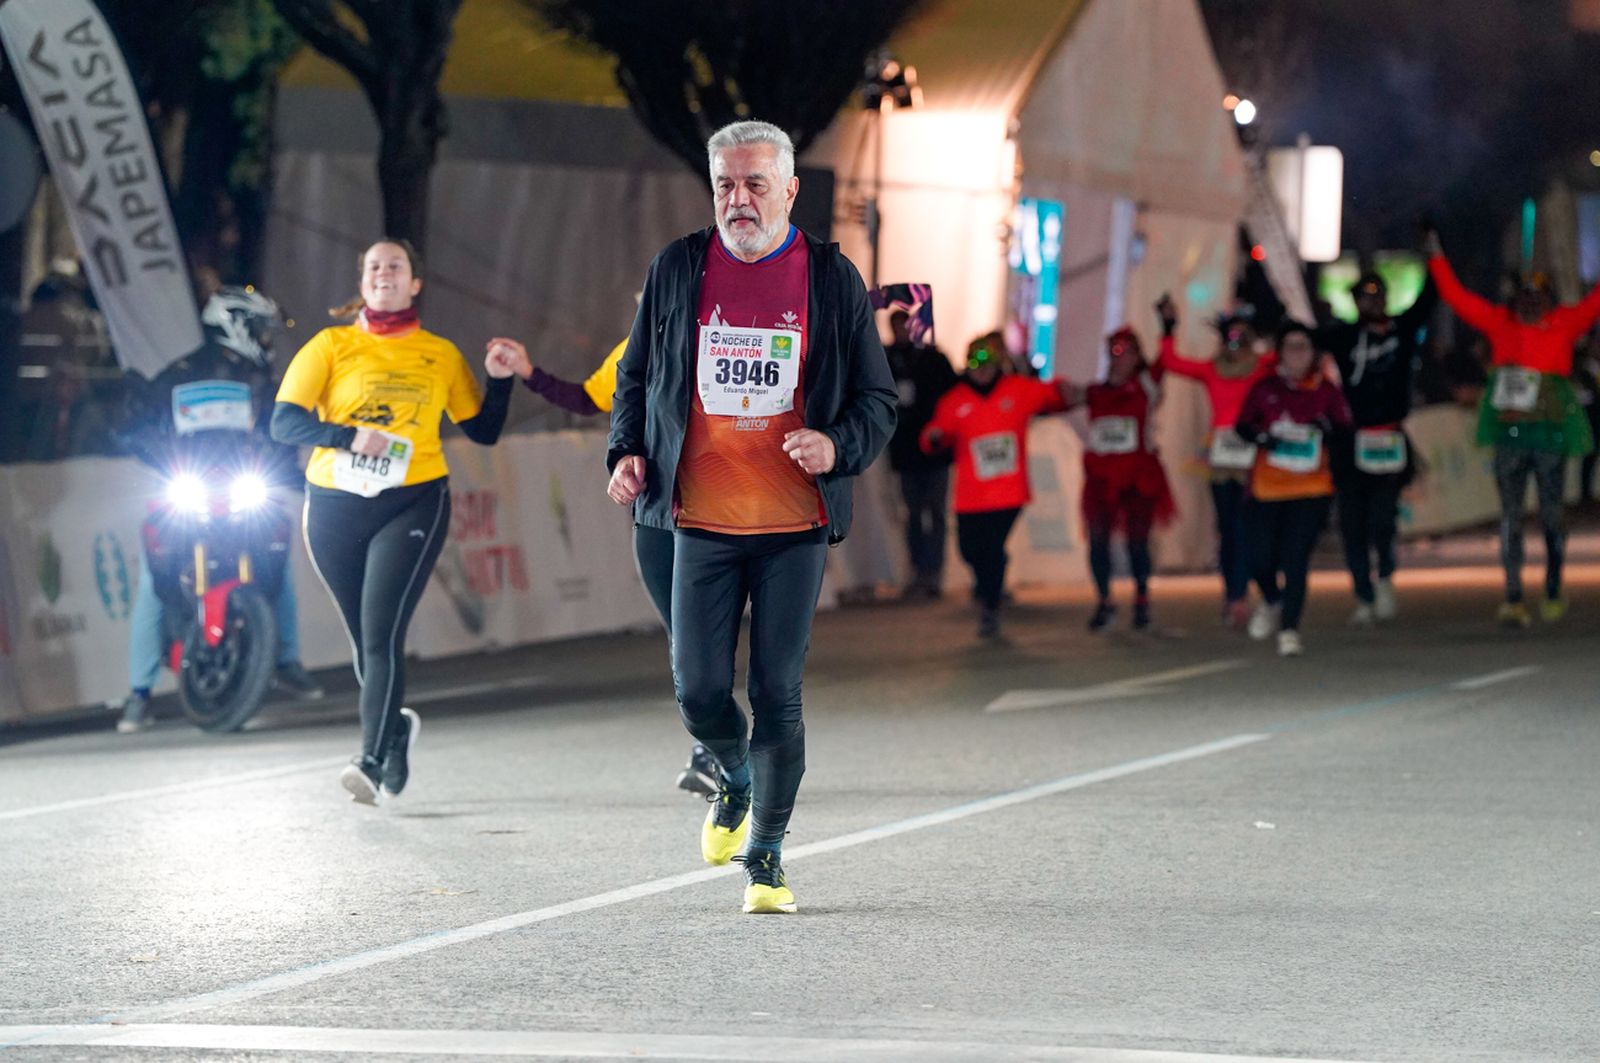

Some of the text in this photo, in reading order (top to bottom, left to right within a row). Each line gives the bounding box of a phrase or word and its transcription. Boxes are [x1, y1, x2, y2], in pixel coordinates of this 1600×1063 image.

[64, 17, 176, 275] JAPEMASA
[721, 335, 750, 347] NOCHE
[751, 337, 763, 348] DE
[709, 346, 729, 356] SAN
[730, 346, 762, 358] ANTÓN
[715, 358, 780, 387] 3946
[723, 386, 769, 395] Eduardo Miguel
[350, 452, 392, 477] 1448
